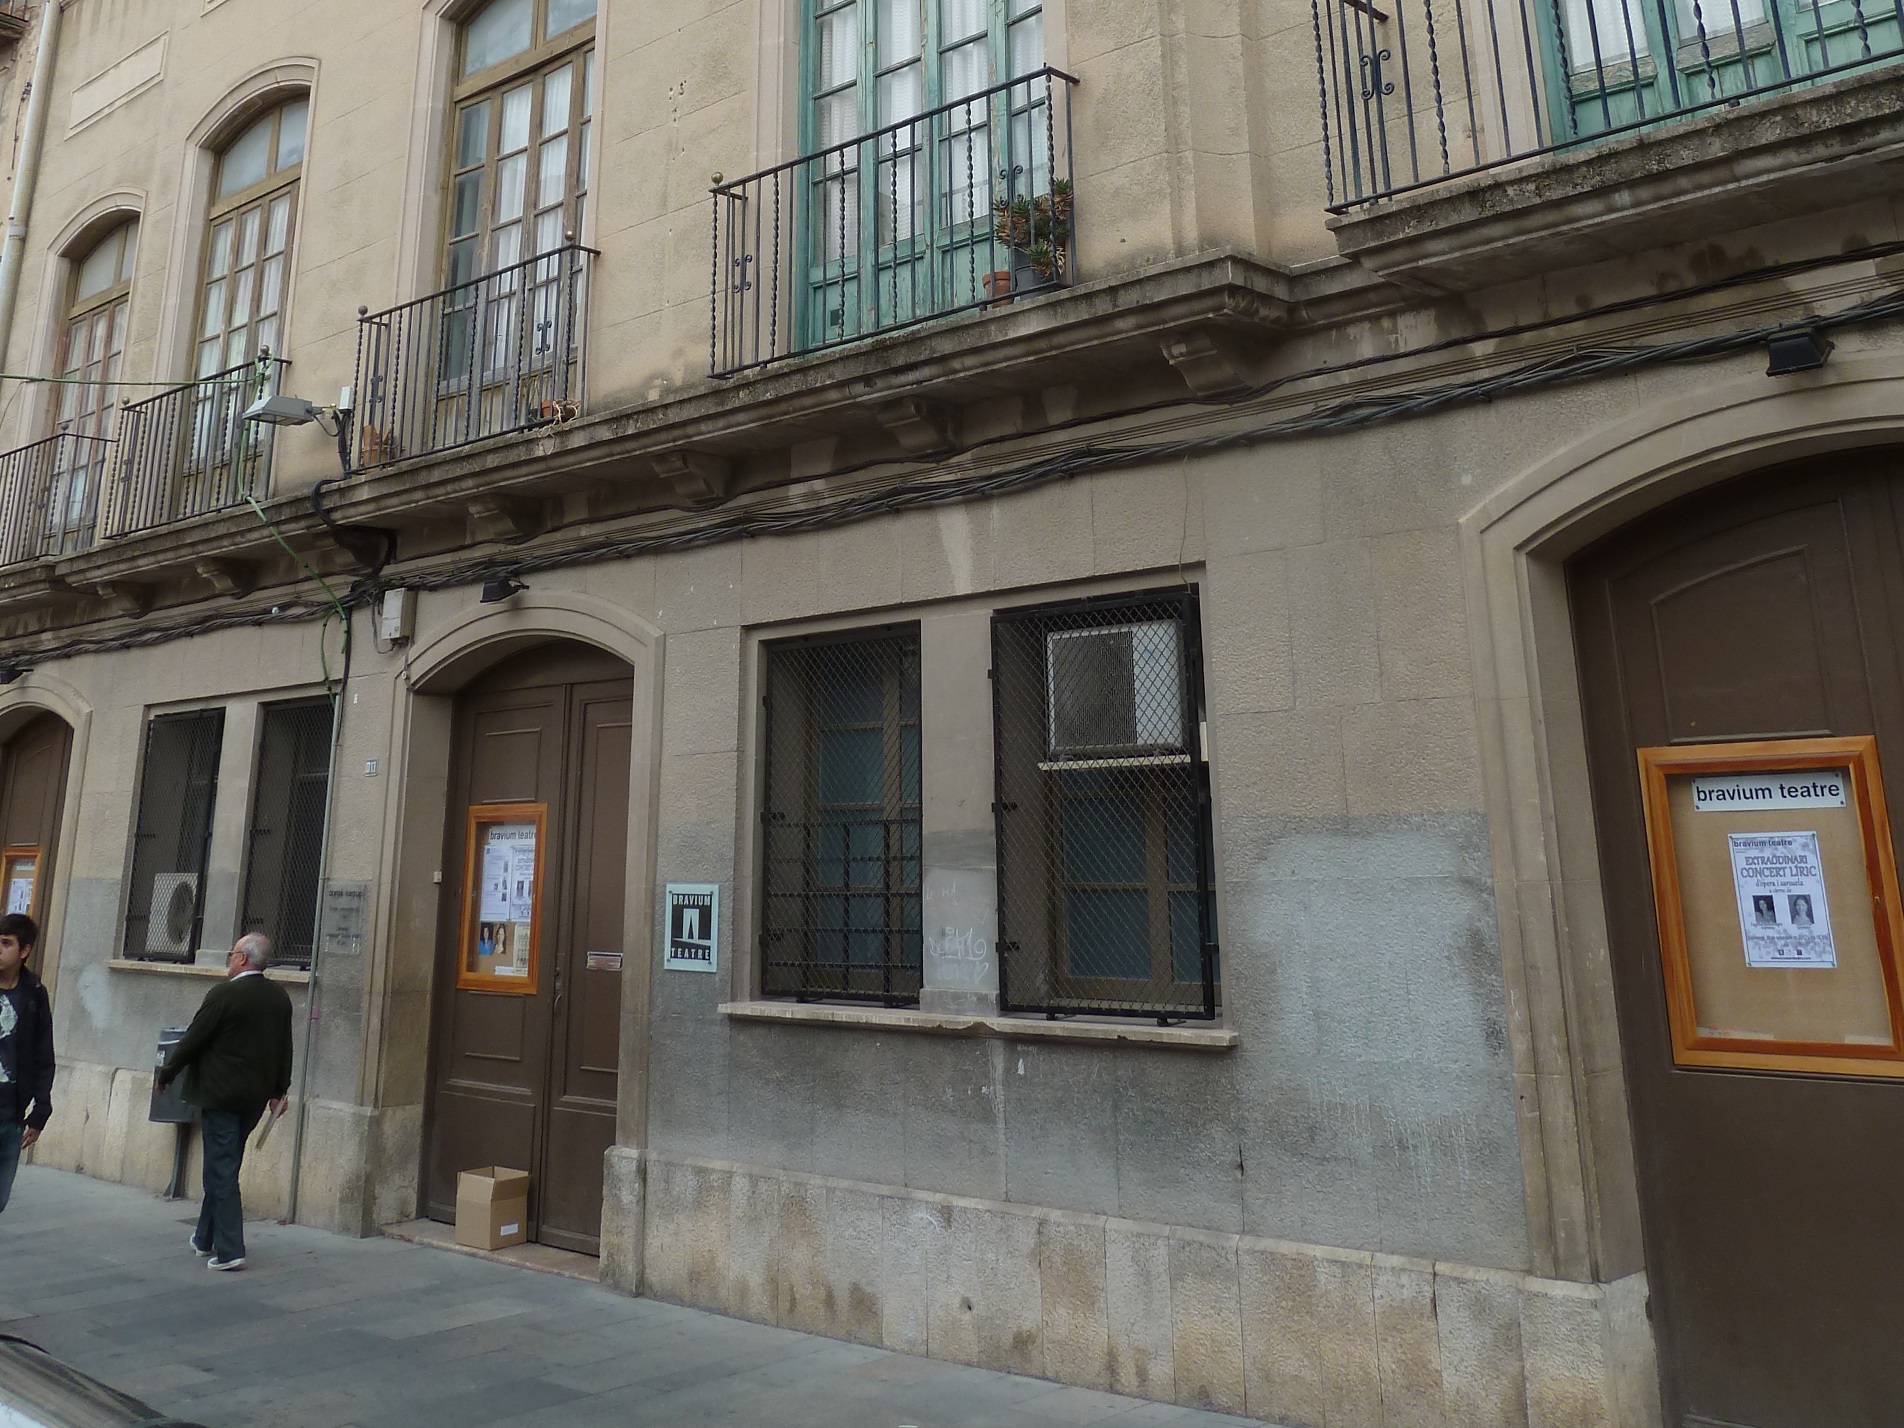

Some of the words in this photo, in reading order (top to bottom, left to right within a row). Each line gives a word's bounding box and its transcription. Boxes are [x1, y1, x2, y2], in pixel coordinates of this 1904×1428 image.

[1696, 784, 1773, 801] bravium
[1779, 782, 1840, 799] teatre
[490, 830, 516, 840] bravium
[518, 830, 535, 840] teatr
[1733, 840, 1767, 848] bravium
[1768, 839, 1793, 847] teatre
[1740, 866, 1787, 878] CONCERT
[1789, 863, 1817, 877] LÍRIC
[672, 894, 711, 906] BRAVIUM
[671, 947, 710, 960] TEATRE
